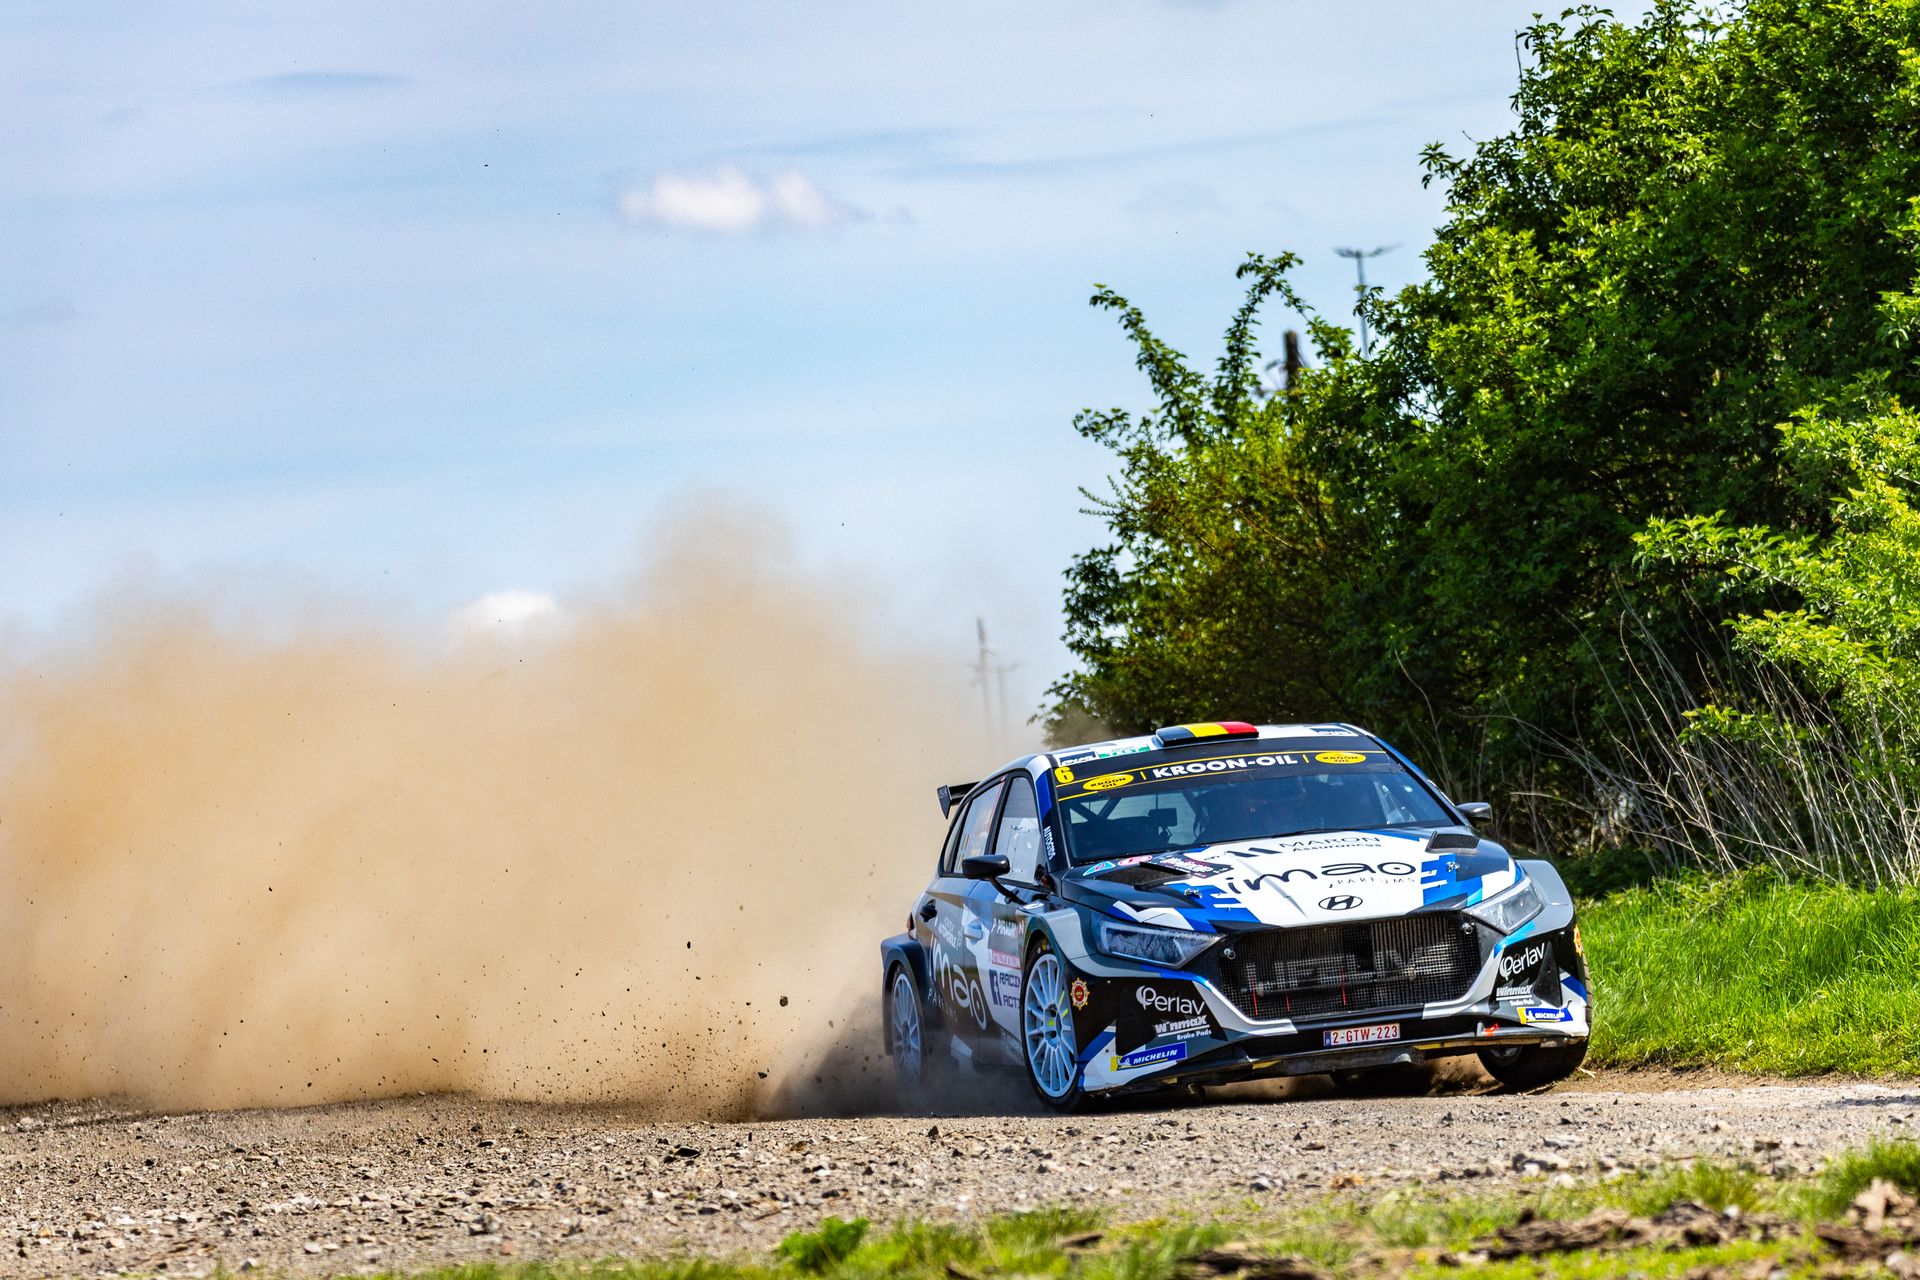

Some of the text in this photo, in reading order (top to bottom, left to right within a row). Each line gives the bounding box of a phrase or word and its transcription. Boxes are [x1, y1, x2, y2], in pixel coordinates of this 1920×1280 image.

[1054, 766, 1075, 784] 6
[1153, 755, 1298, 778] KROON-OIL
[1279, 836, 1381, 848] MARON
[1293, 843, 1382, 852] Assurances
[1226, 862, 1417, 894] imao
[1499, 943, 1545, 981] Perlav
[1135, 985, 1205, 1015] Perlav
[1332, 1025, 1398, 1044] 2-GTW-223
[1133, 1049, 1178, 1064] MICHELIN
